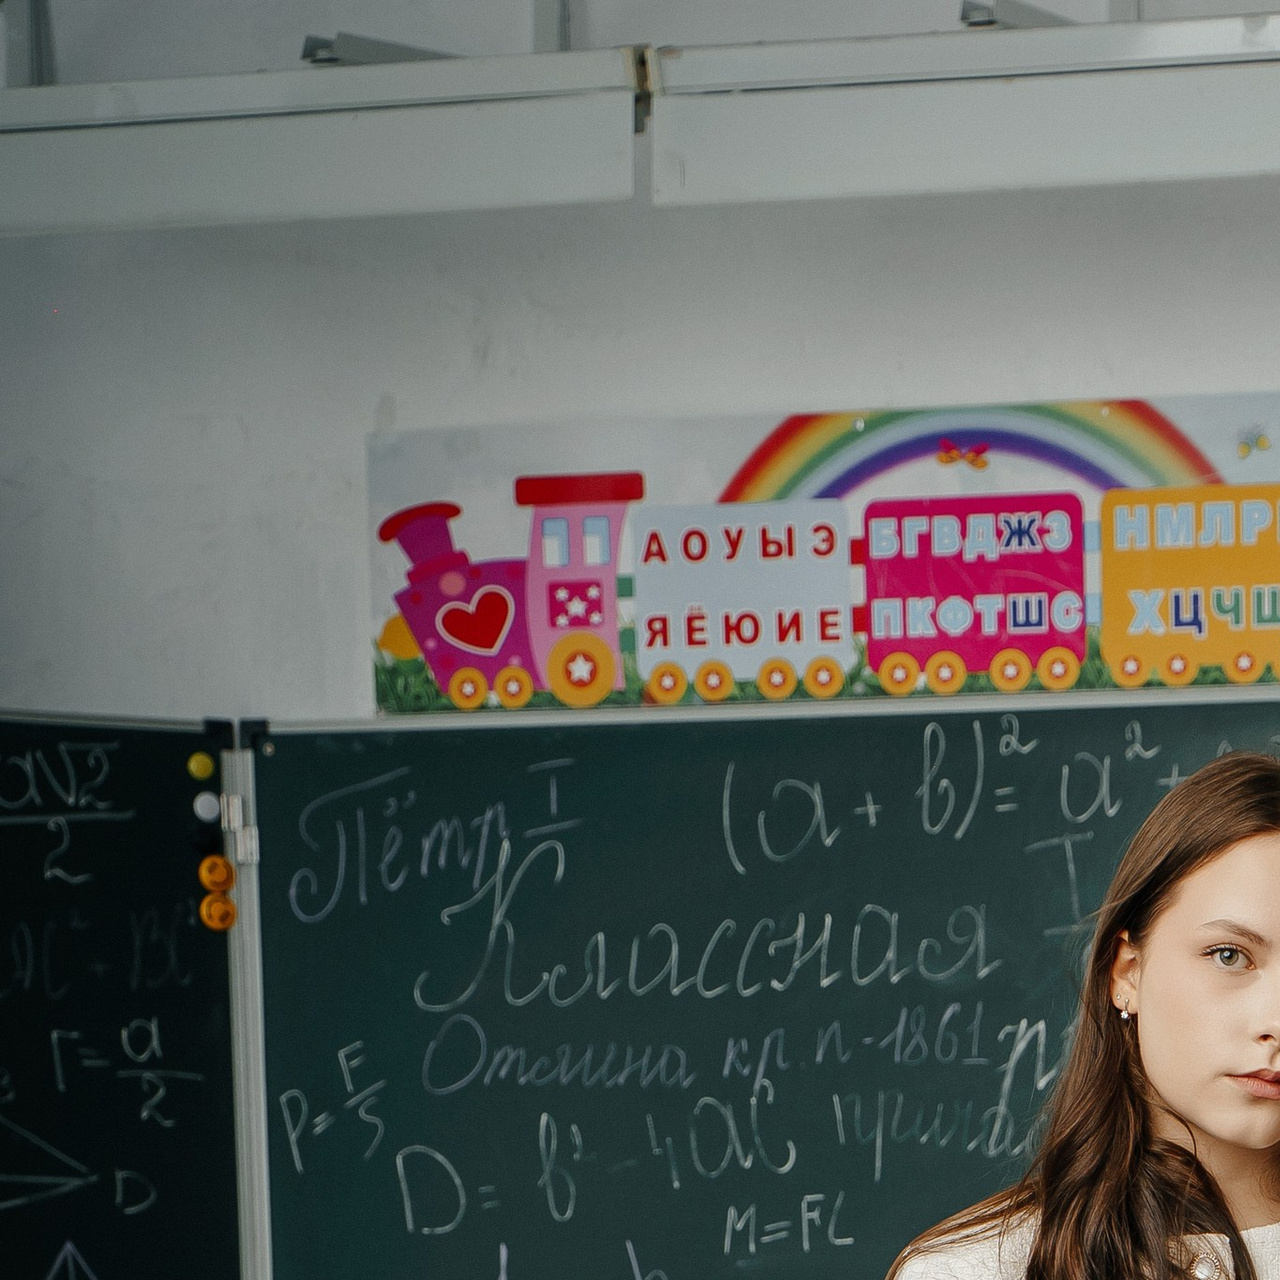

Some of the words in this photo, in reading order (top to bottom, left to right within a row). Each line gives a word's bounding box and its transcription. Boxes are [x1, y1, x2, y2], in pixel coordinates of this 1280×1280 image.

[868, 510, 1073, 563] БГВДЖЗ
[871, 590, 1083, 640] ПКФТШС
[413, 838, 1002, 1012] Классная
